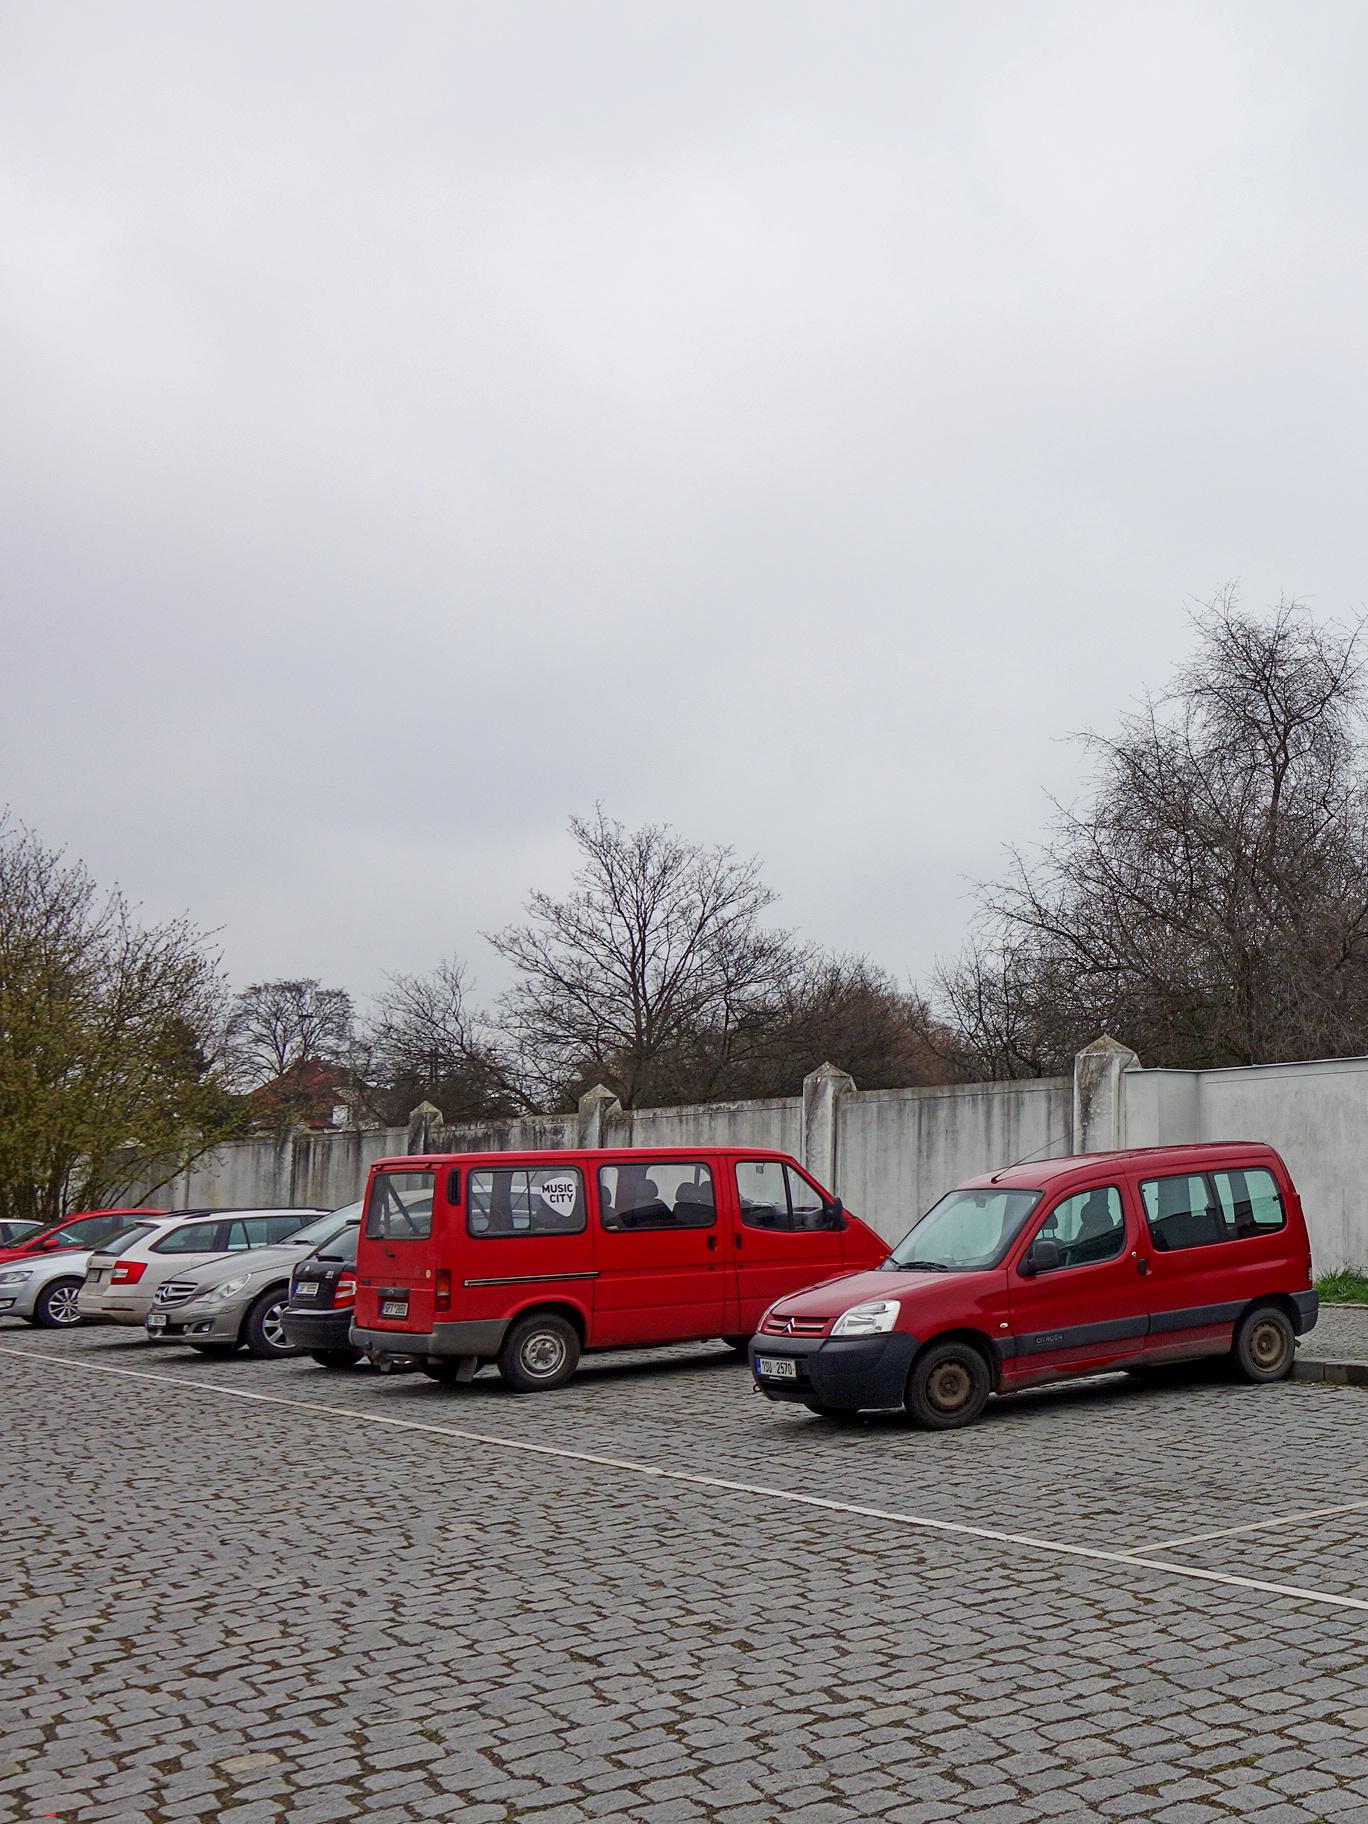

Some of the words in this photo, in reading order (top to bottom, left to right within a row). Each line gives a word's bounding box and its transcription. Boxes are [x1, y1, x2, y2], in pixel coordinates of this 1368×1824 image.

[542, 1184, 573, 1193] MUSIC
[550, 1194, 573, 1203] CITY
[776, 1362, 793, 1375] 2570
